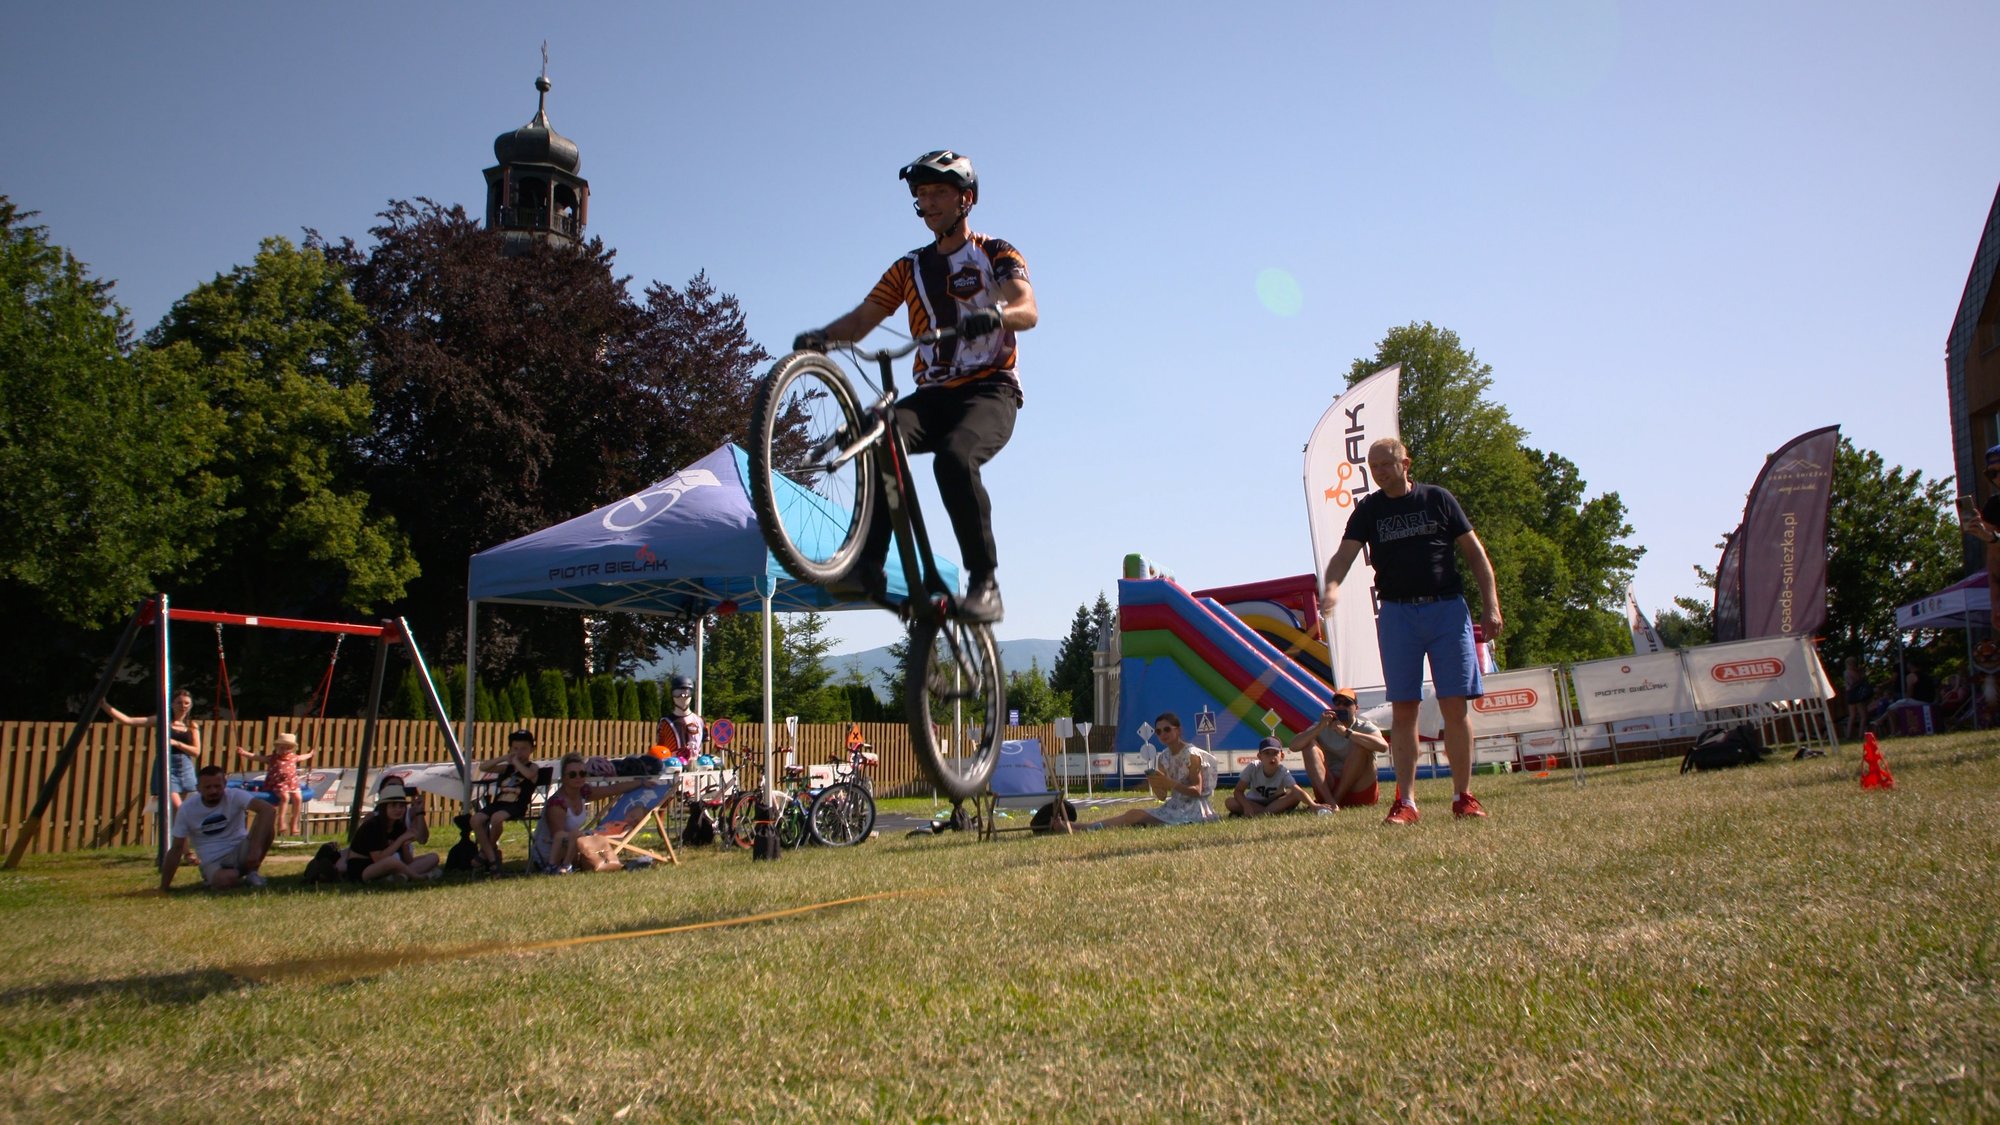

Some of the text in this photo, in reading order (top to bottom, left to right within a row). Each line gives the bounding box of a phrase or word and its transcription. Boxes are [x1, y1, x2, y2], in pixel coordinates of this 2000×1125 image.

[1376, 510, 1437, 531] KARL
[548, 559, 669, 581] PIOTR BIELAK
[1779, 512, 1798, 633] osada-sniezka.pl
[1723, 662, 1776, 679] ABUS
[1594, 683, 1668, 698] PIOTR BIELAK
[1481, 693, 1529, 709] ABUS
